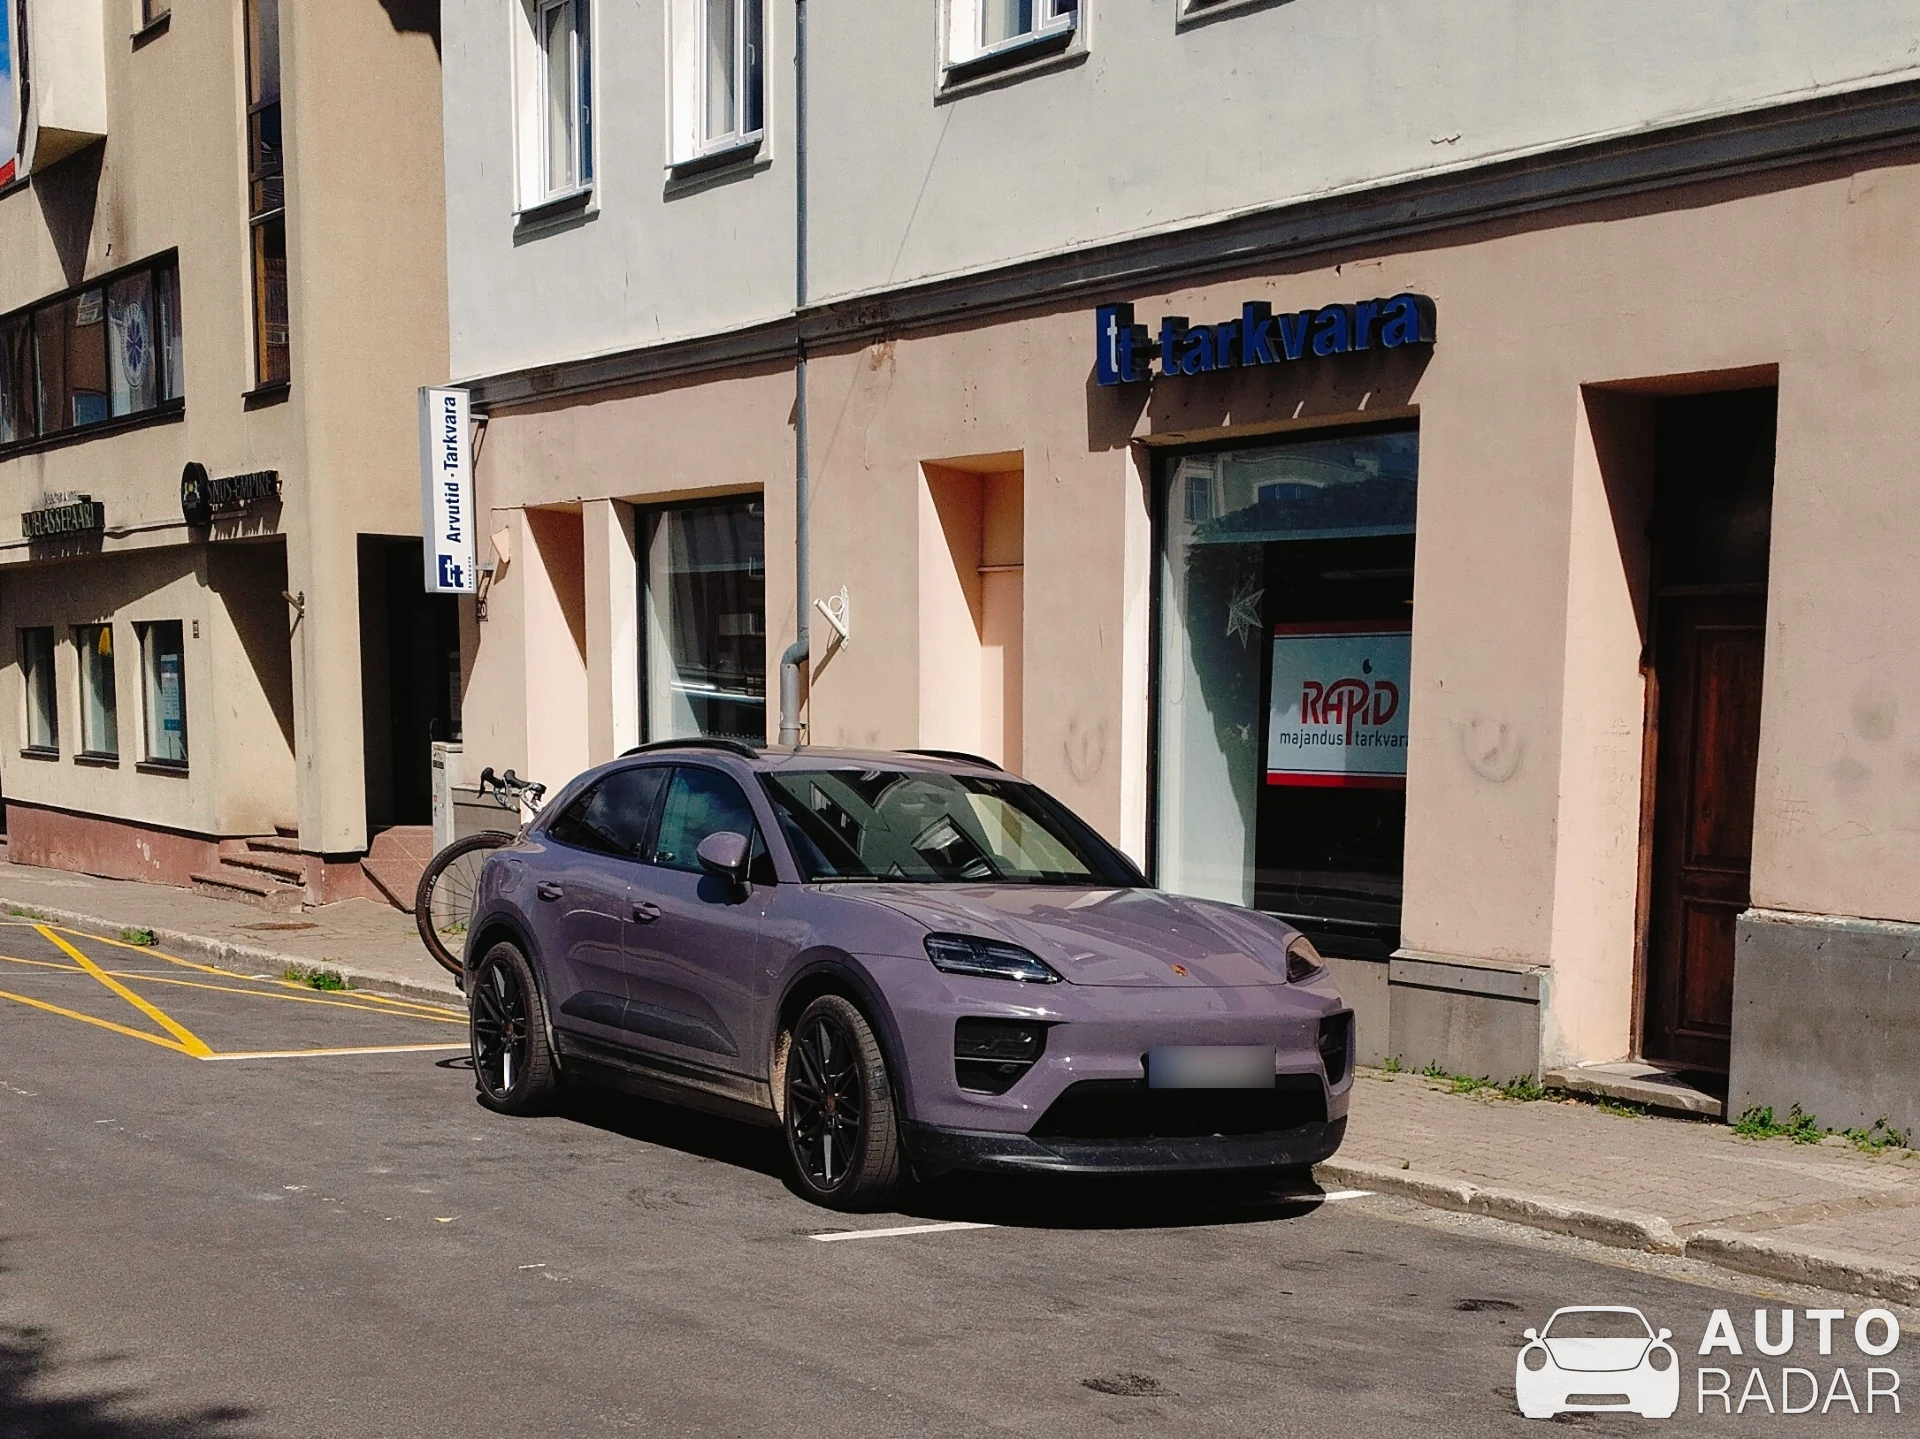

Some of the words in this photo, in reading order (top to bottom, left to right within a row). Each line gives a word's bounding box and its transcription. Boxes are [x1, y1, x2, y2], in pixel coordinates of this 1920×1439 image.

[1160, 294, 1424, 377] tarkvara
[443, 396, 459, 470] Tarkvara
[444, 482, 461, 543] Arvutid
[1279, 729, 1344, 749] majandus
[1301, 677, 1399, 746] RAPID
